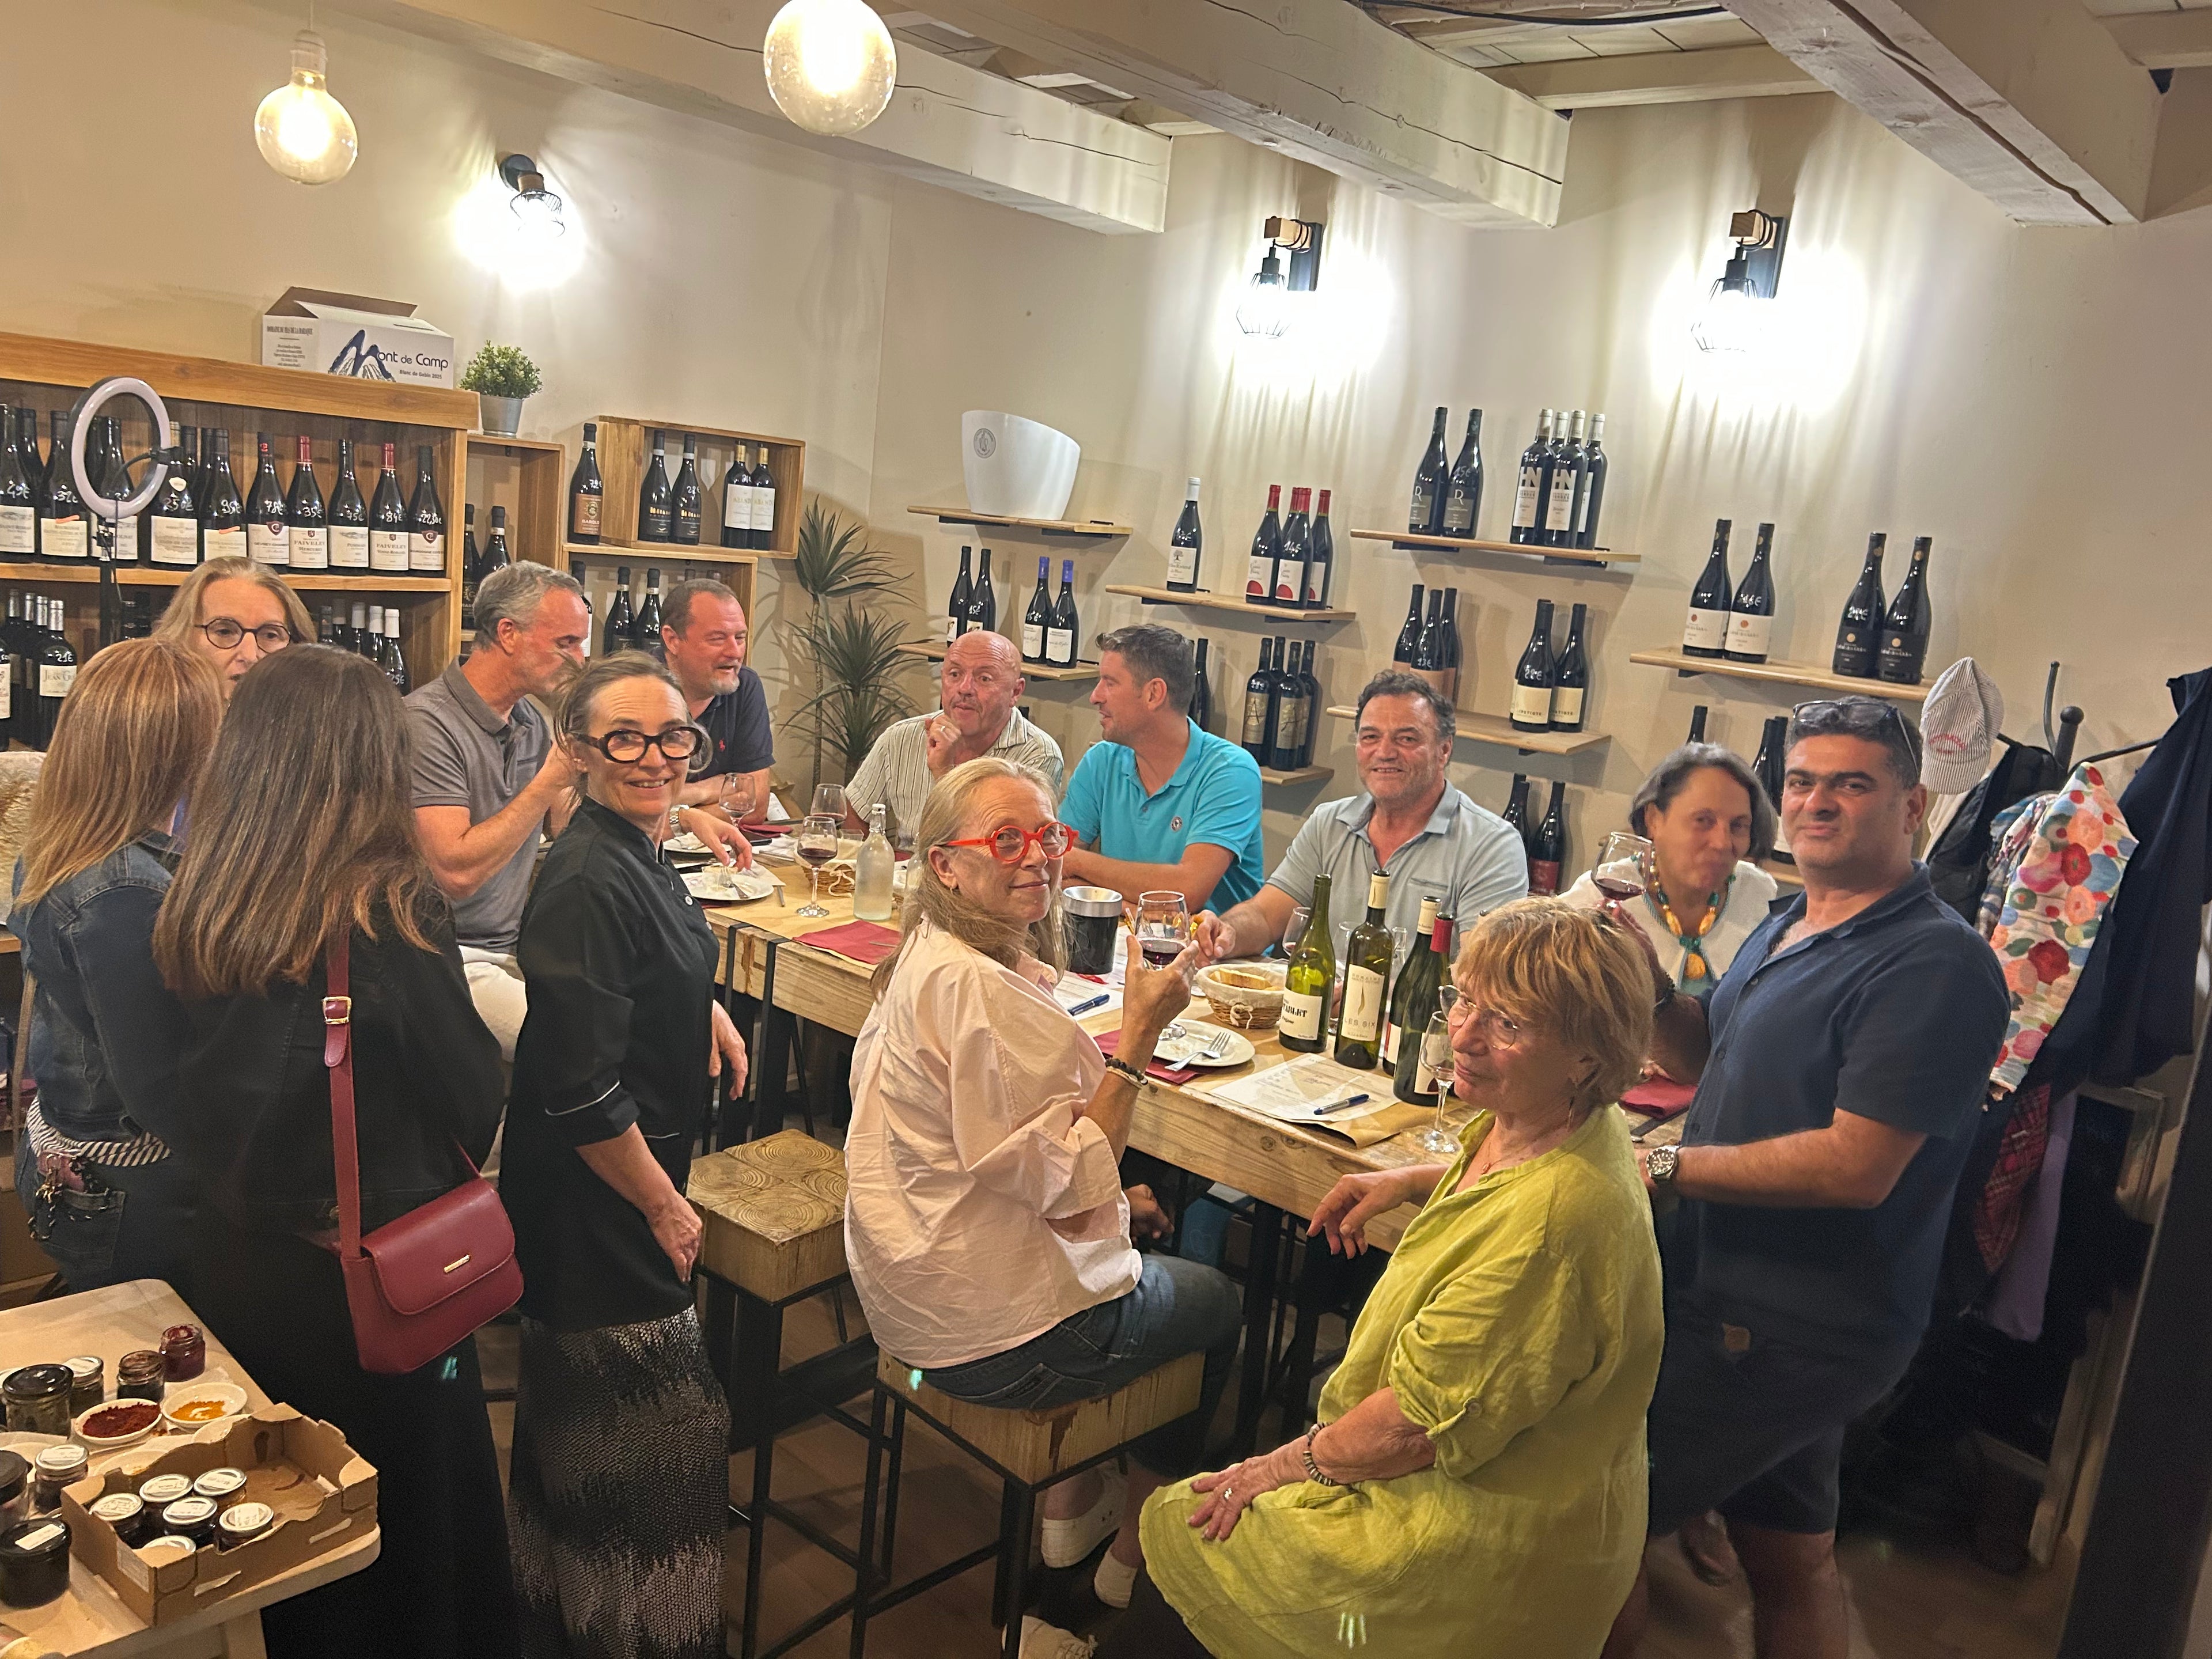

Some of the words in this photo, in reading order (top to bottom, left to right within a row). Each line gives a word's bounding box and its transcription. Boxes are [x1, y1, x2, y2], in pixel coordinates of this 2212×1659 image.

[400, 355, 412, 364] de
[416, 353, 448, 371] Camp
[1344, 1018, 1359, 1027] LES
